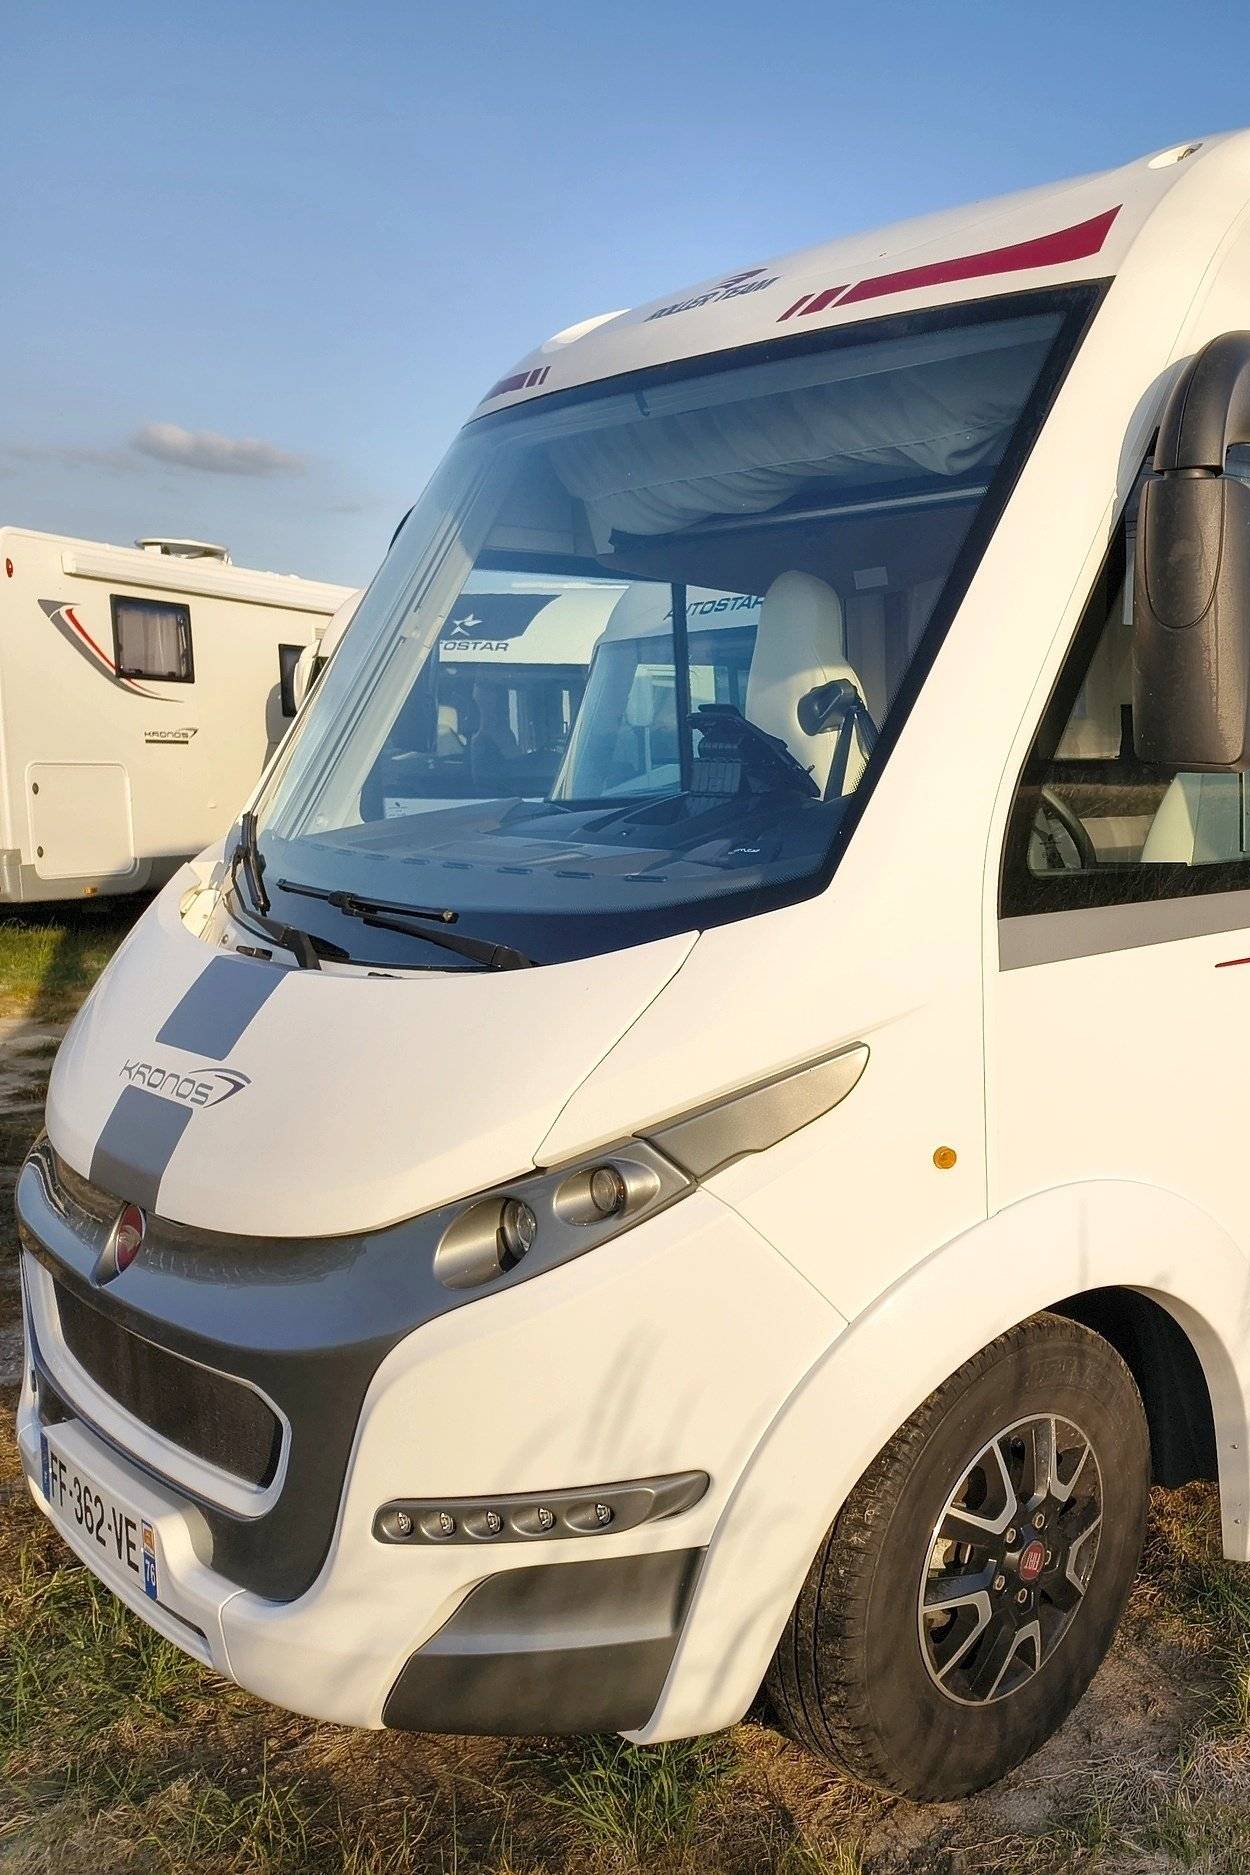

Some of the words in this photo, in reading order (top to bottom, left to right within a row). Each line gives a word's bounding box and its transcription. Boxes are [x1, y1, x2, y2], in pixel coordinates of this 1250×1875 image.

[711, 276, 781, 304] TEAM
[119, 1058, 214, 1106] KRONOS
[50, 1450, 140, 1574] FF-362-VE
[145, 1559, 157, 1587] 76
